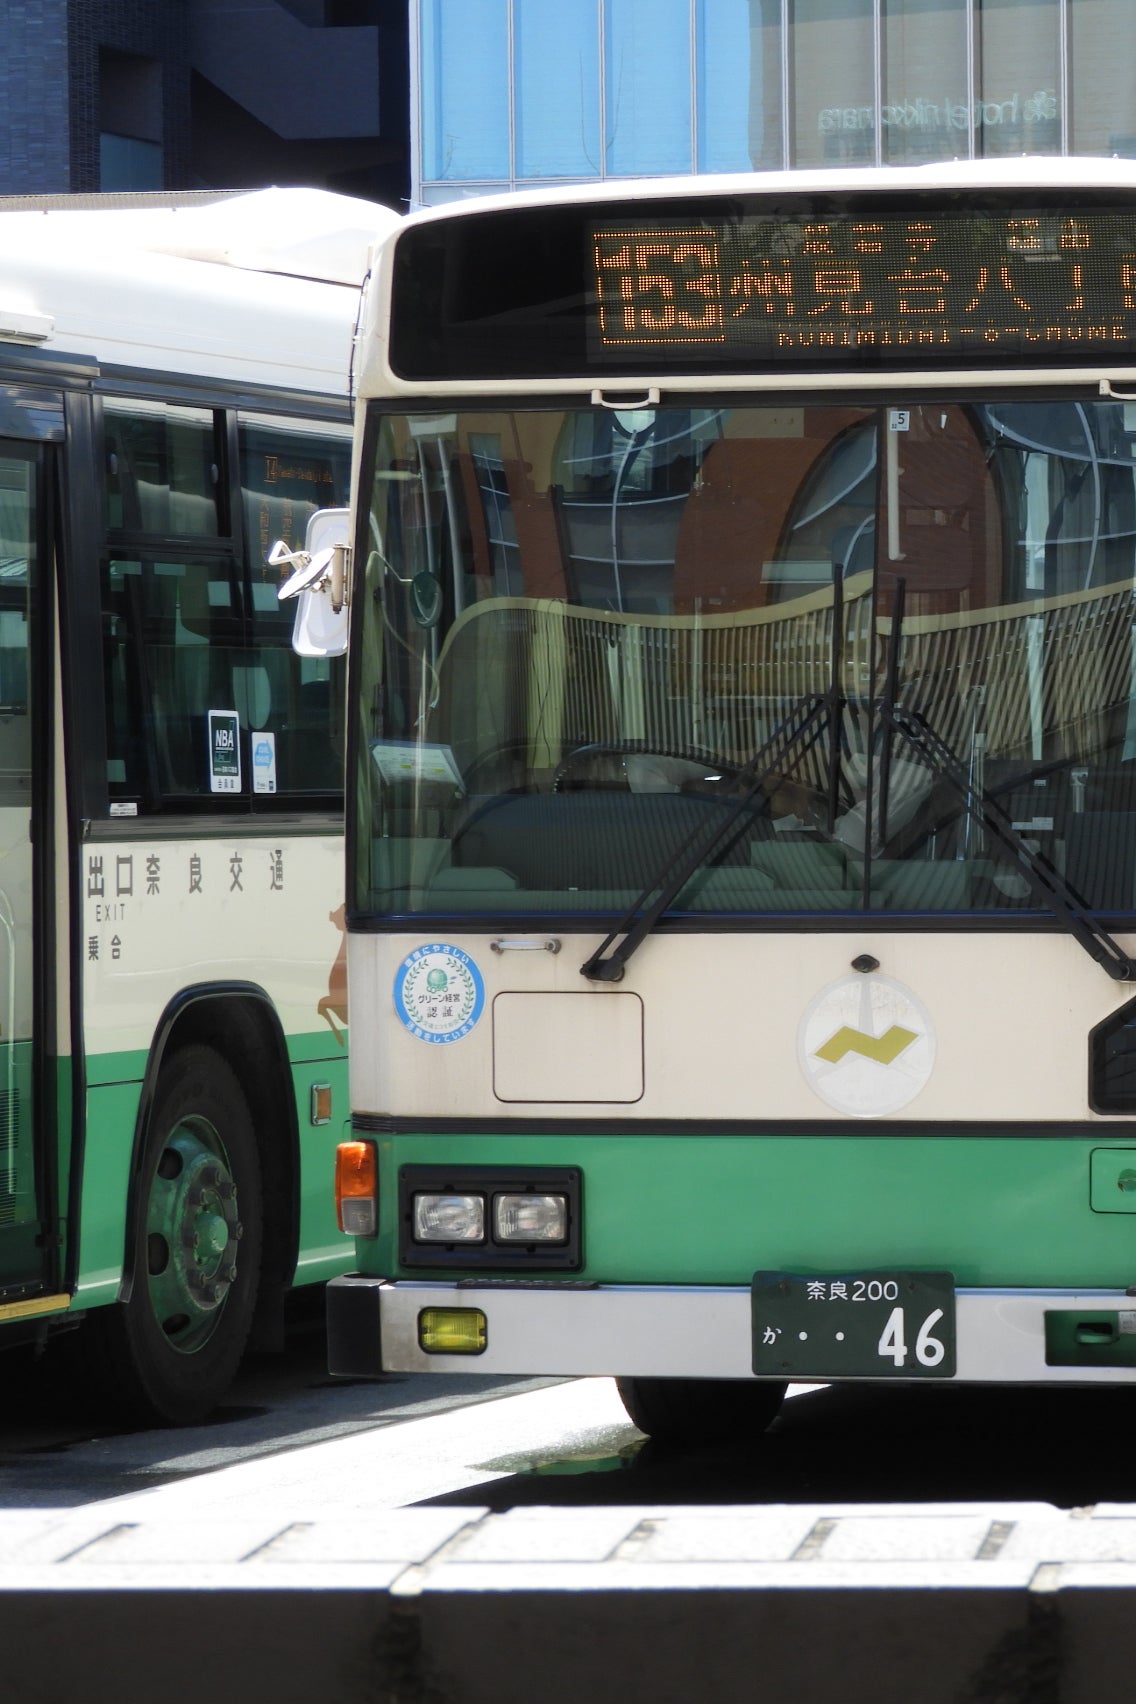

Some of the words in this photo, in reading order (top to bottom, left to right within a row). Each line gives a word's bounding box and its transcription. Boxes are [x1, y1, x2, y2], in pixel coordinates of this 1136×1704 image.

[602, 244, 718, 332] 153
[897, 412, 905, 425] 5
[215, 729, 235, 747] NBA
[88, 854, 134, 898] 出口
[146, 849, 283, 896] 奈良交通
[95, 903, 126, 922] EXIT
[88, 934, 122, 961] 乗合
[418, 993, 461, 1004] グリーン経営
[426, 1006, 454, 1018] 認証
